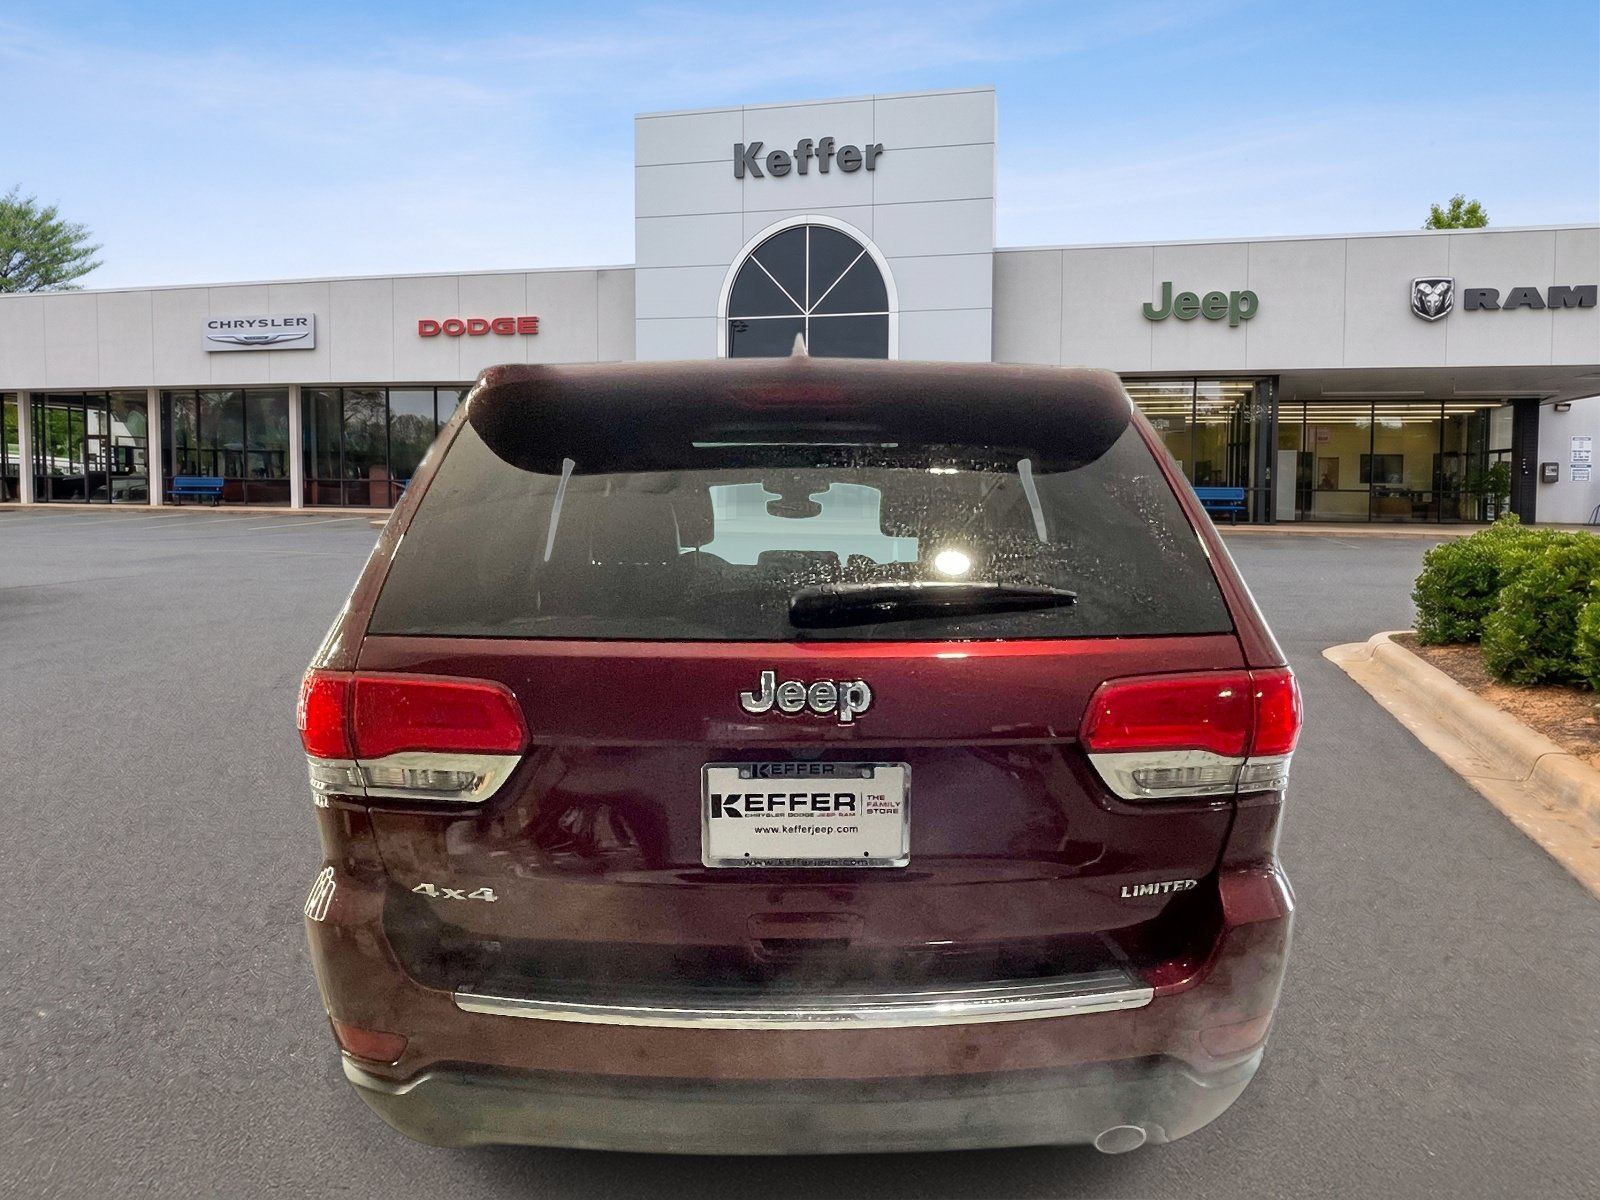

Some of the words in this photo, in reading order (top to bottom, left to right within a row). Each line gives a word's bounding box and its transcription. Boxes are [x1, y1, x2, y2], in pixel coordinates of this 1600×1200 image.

[733, 136, 883, 178] Keffer
[1142, 281, 1259, 327] Jeep
[1463, 285, 1598, 310] RAM
[207, 317, 308, 330] CHRYSLER
[418, 316, 539, 337] DODGE
[740, 670, 871, 722] Jeep
[751, 763, 835, 778] KEFFER
[710, 793, 856, 818] KEFFER
[754, 824, 859, 835] www.kefferjeep.com
[411, 883, 498, 902] 4x4
[1120, 879, 1198, 898] LIMITED
